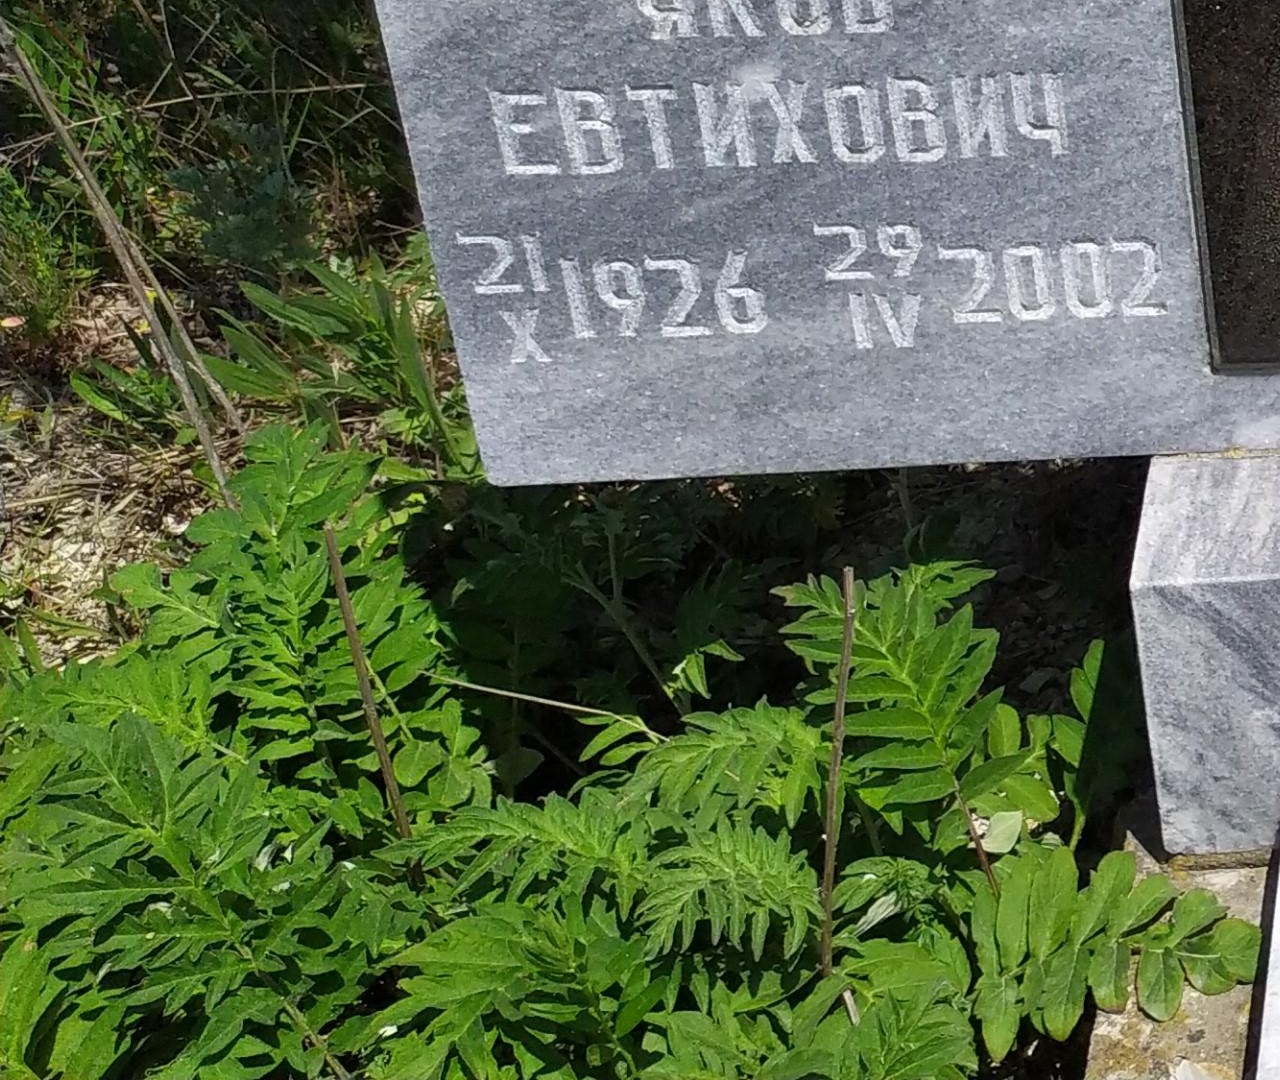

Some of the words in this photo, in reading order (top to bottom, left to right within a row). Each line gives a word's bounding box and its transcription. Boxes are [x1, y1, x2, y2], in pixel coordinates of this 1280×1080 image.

[489, 72, 1067, 175] ЕВТИХОВИЧ
[455, 231, 550, 294] 21
[558, 249, 768, 339] 1926
[812, 222, 924, 281] 29
[937, 237, 1169, 323] 2002
